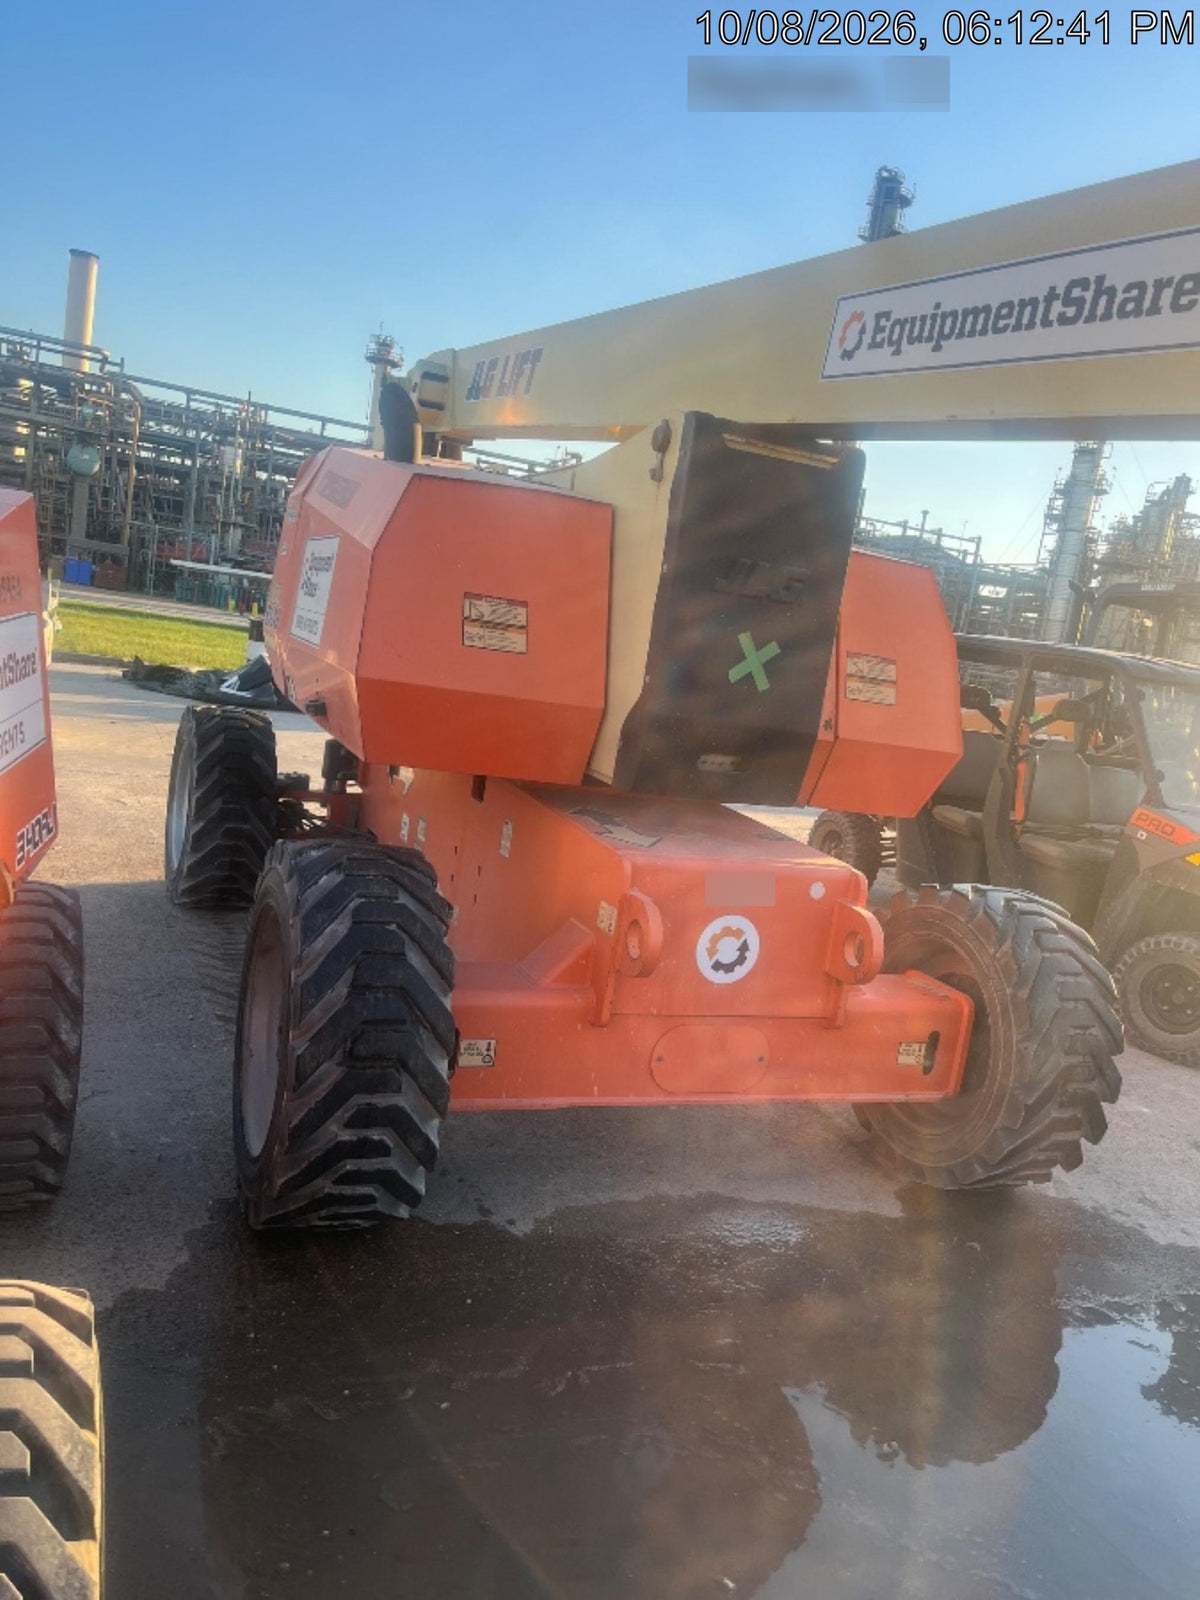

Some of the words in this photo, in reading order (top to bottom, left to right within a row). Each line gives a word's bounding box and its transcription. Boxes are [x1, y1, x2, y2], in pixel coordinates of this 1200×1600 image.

[867, 271, 1200, 356] EquipmentShare
[496, 347, 544, 398] LIFT
[1134, 811, 1176, 837] PRO
